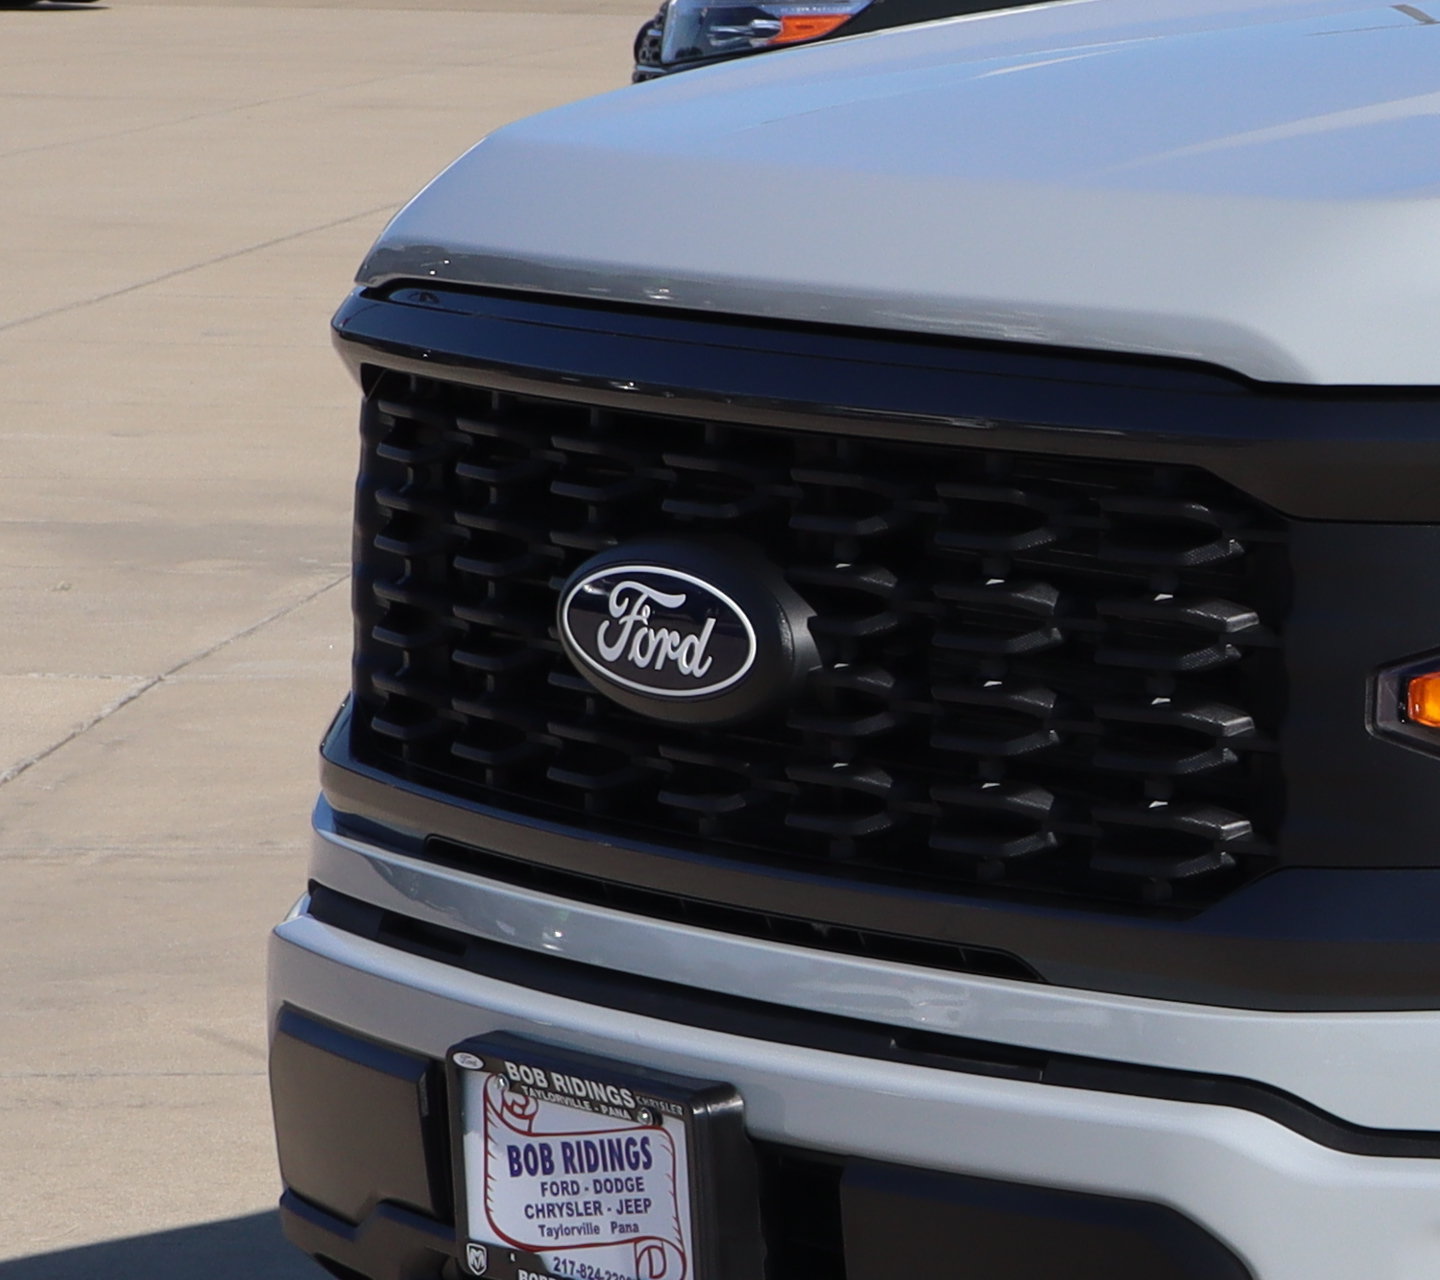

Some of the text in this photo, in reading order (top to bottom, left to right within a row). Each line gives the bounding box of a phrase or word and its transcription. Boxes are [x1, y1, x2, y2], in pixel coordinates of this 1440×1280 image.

[596, 580, 717, 679] Ford
[504, 1061, 637, 1110] BOB RIDINGS
[521, 1085, 592, 1112] TAYLORVILLE
[601, 1104, 633, 1121] PANA
[636, 1095, 684, 1116] CHRYSLER
[507, 1135, 654, 1178] BOB RIDINGS
[540, 1180, 580, 1197] FORD
[593, 1176, 645, 1193] DODGE
[524, 1200, 604, 1220] CHRYSLER
[615, 1197, 652, 1216] JEEP
[537, 1221, 640, 1240] Taylorville Pana
